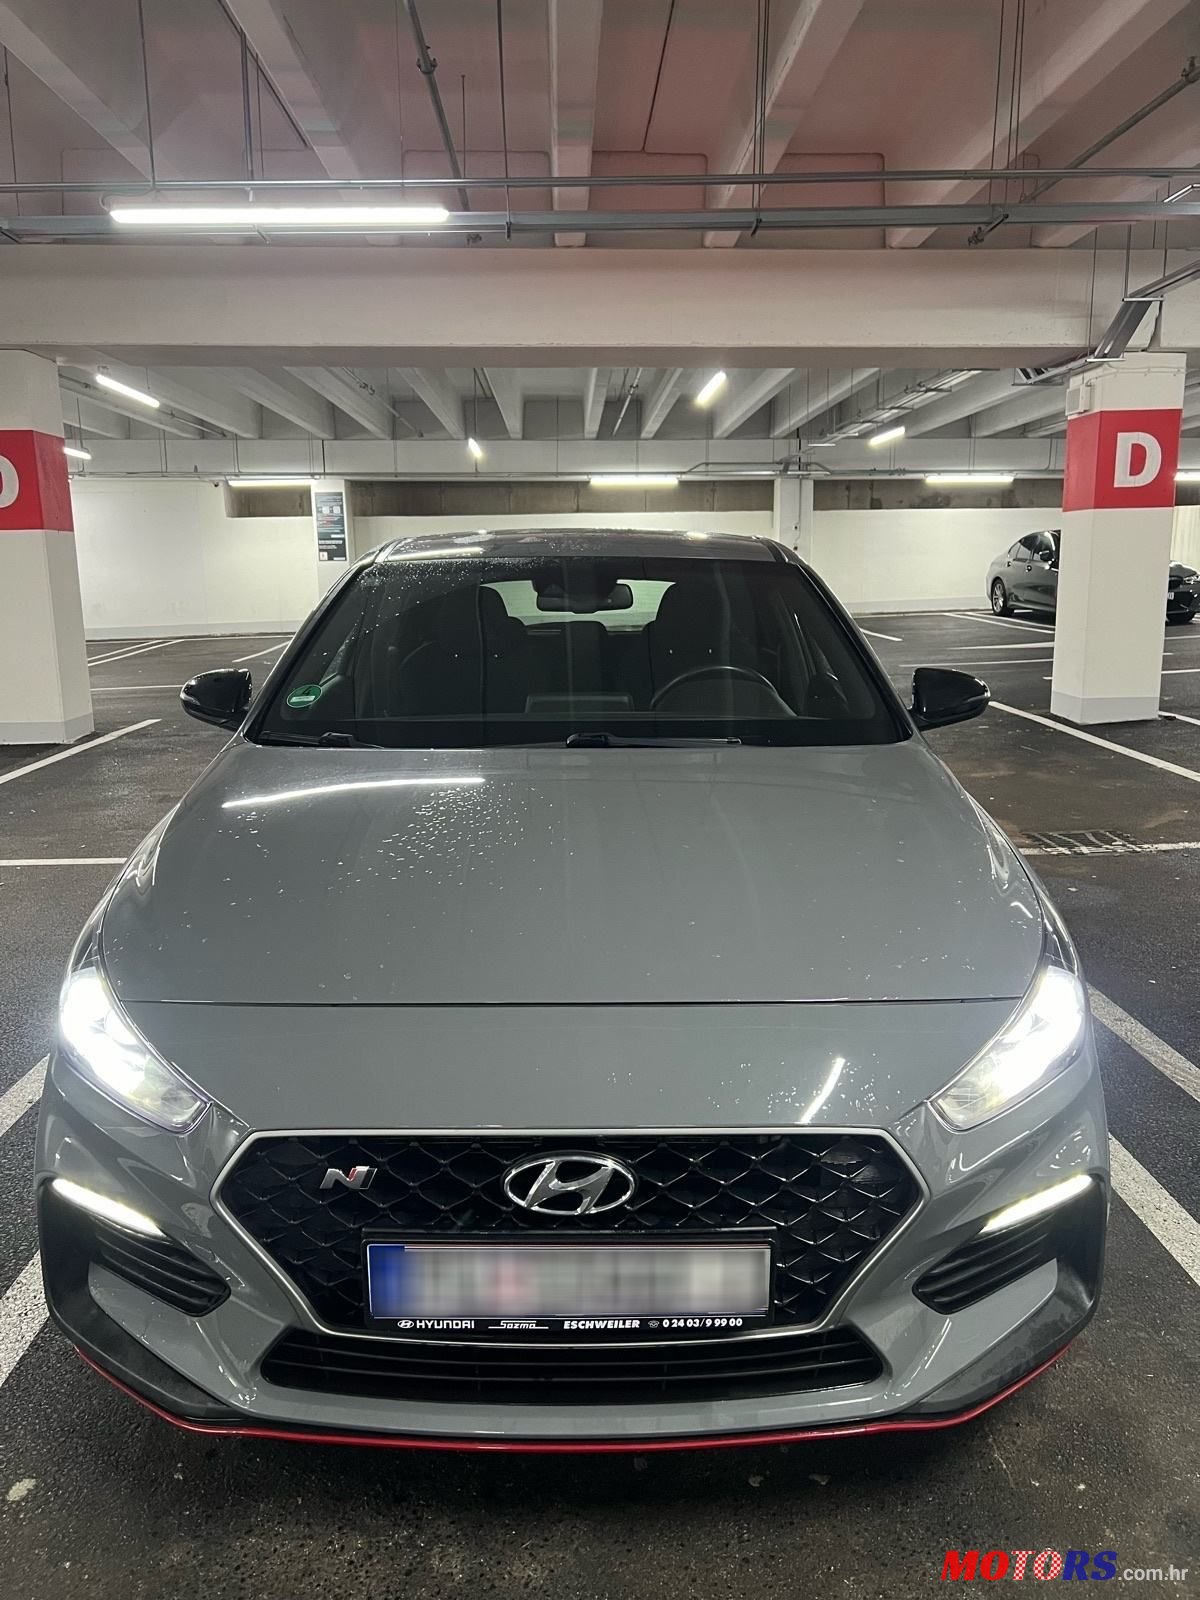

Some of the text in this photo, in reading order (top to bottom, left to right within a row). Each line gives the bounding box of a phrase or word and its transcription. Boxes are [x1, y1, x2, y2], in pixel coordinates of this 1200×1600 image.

[1113, 431, 1162, 488] D
[416, 1319, 475, 1329] HYUNDAI
[563, 1319, 641, 1330] ESCHWEILER
